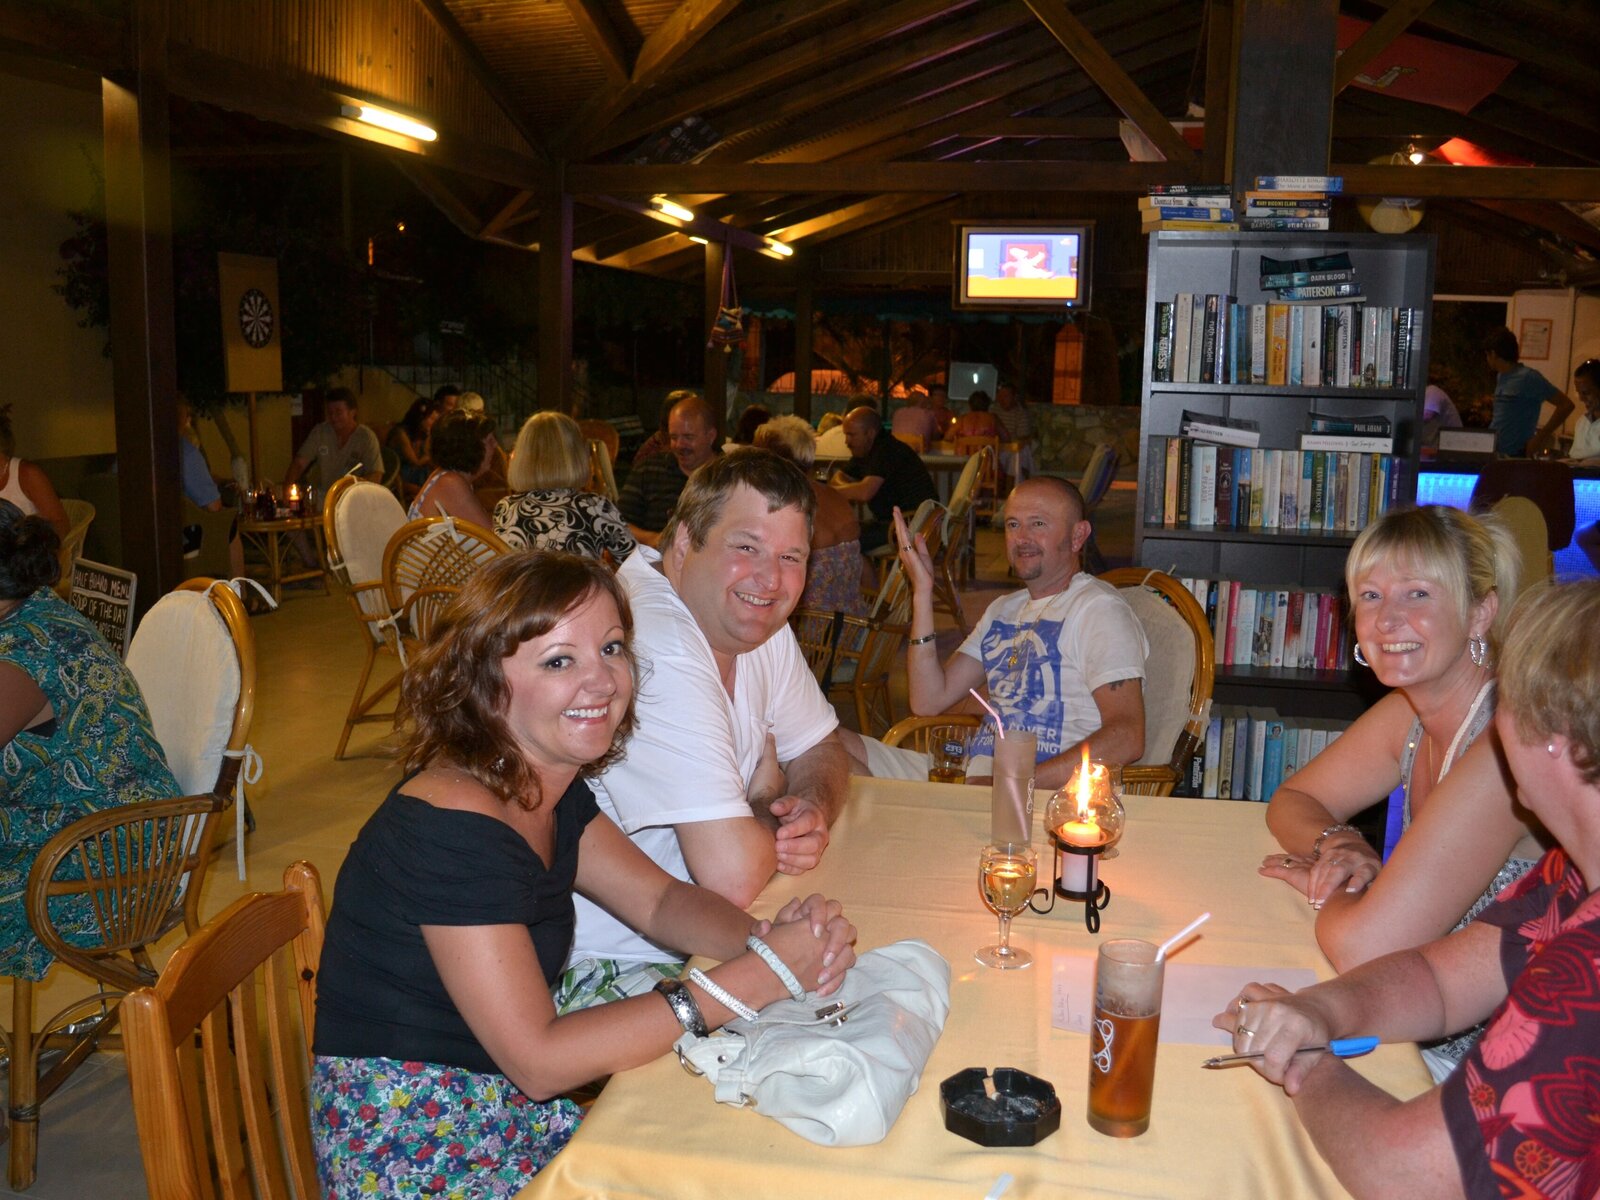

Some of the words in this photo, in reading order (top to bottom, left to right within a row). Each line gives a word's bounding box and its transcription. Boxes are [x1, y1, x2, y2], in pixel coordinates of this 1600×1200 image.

[1310, 274, 1326, 282] DARK
[1326, 273, 1346, 281] BLOOD
[1297, 286, 1336, 297] PATTERSON
[1400, 310, 1408, 323] KEN
[1208, 320, 1216, 336] ruth
[1398, 325, 1408, 350] FOLLETT
[1157, 336, 1168, 369] NEMESIS
[1206, 338, 1214, 362] rendell
[1353, 424, 1366, 432] PAUL
[74, 570, 88, 587] HALF
[89, 572, 108, 592] BOARD
[110, 580, 130, 599] MENU
[88, 600, 97, 616] OF
[99, 602, 112, 619] THE
[113, 605, 127, 624] DAY
[977, 735, 994, 746] FOR
[1191, 757, 1202, 788] Patterson
